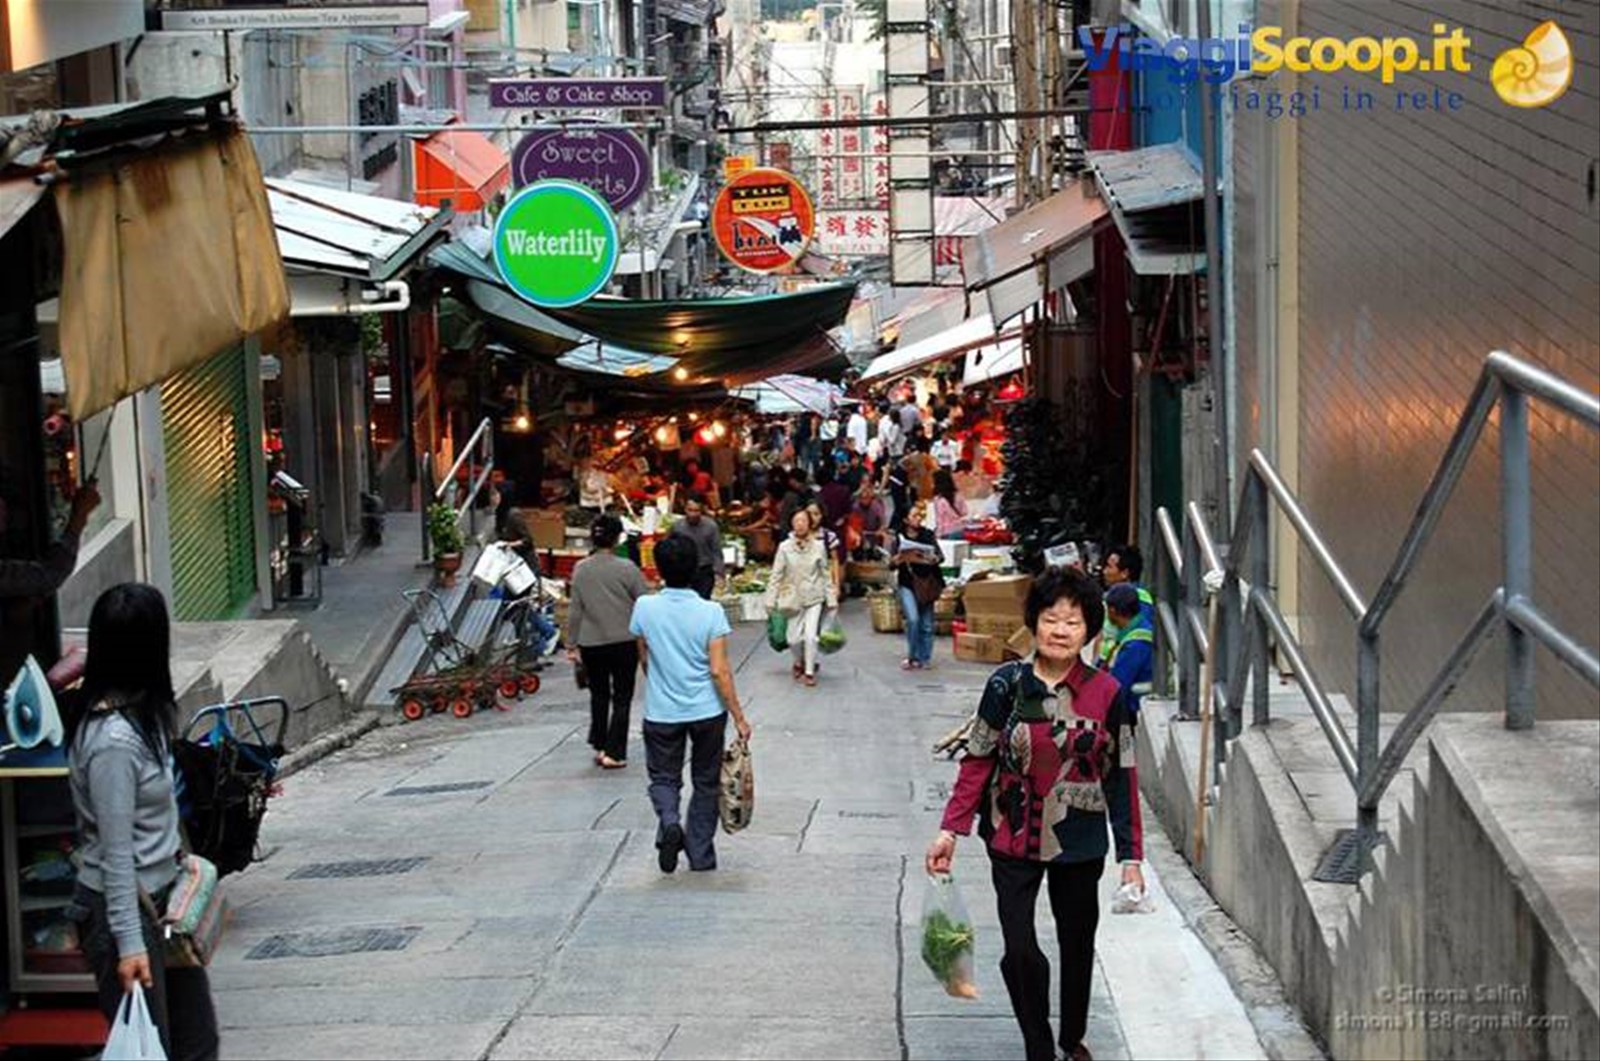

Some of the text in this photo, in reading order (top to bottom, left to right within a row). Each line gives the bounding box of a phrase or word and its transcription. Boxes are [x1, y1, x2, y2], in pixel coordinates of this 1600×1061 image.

[503, 85, 653, 107] Cafe & Cake Shop
[541, 140, 618, 164] Sweet
[735, 185, 785, 197] TUK
[505, 228, 607, 264] Waterlily
